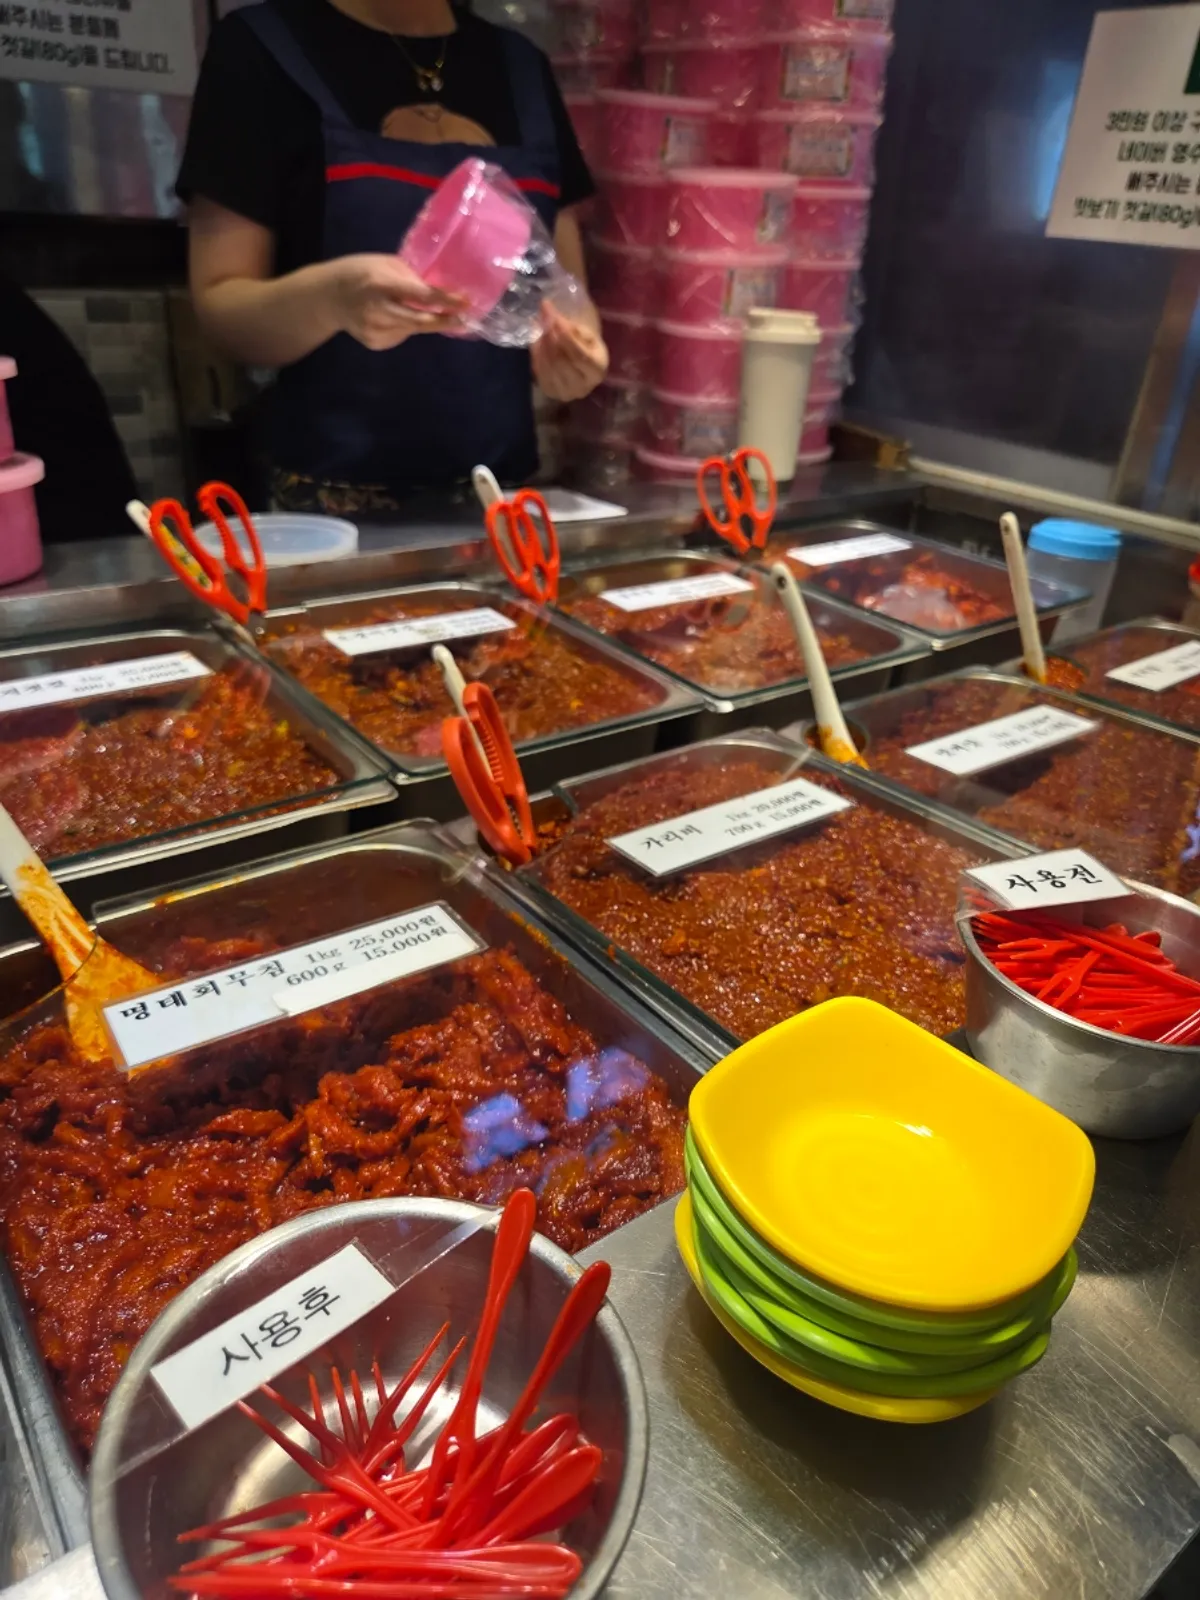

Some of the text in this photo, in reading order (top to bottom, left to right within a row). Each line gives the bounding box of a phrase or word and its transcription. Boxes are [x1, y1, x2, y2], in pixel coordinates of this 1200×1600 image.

[1006, 864, 1103, 893] 사용전
[305, 914, 437, 964] 1kg 25,000원
[119, 960, 286, 1021] 명태회무침
[221, 1285, 341, 1376] 사용후
